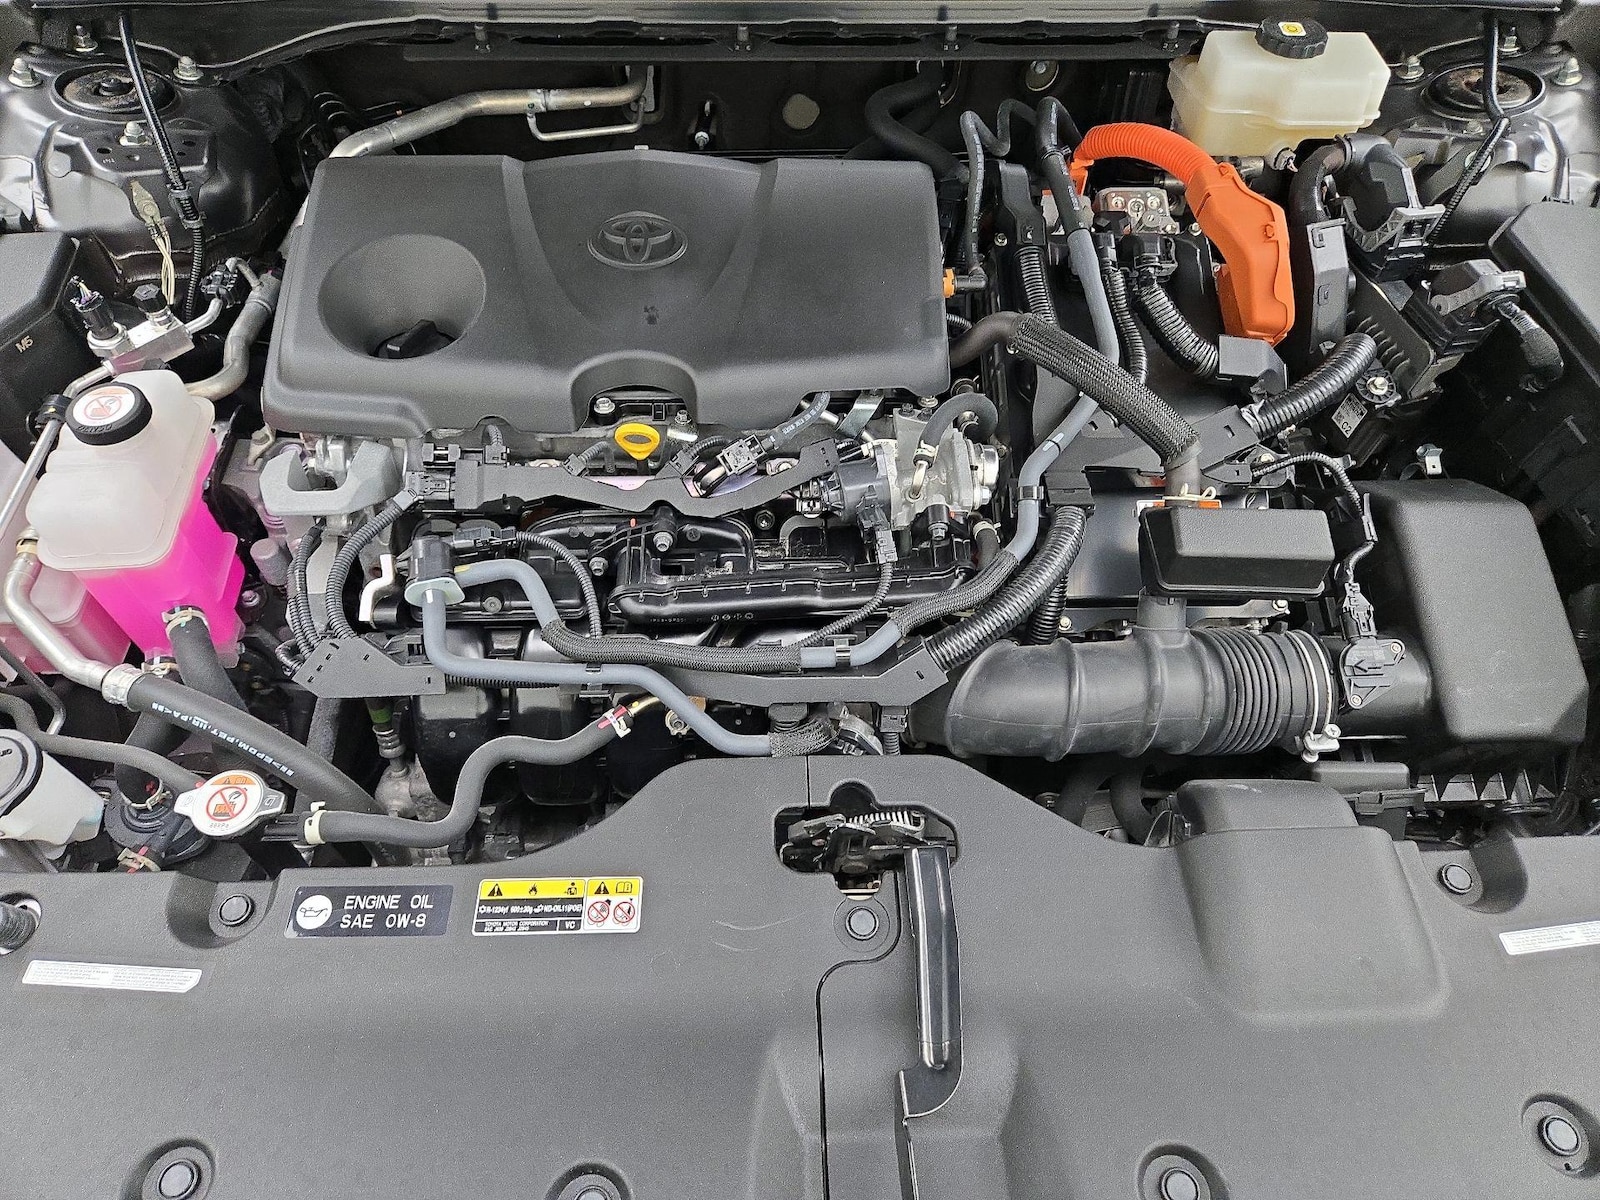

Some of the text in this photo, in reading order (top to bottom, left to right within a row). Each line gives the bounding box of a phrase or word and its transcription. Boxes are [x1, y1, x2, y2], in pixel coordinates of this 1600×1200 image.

[1341, 421, 1352, 435] C2
[344, 894, 434, 910] ENGINE OIL
[339, 913, 376, 929] SAE
[519, 919, 549, 927] CORPORATION
[565, 920, 576, 930] VC
